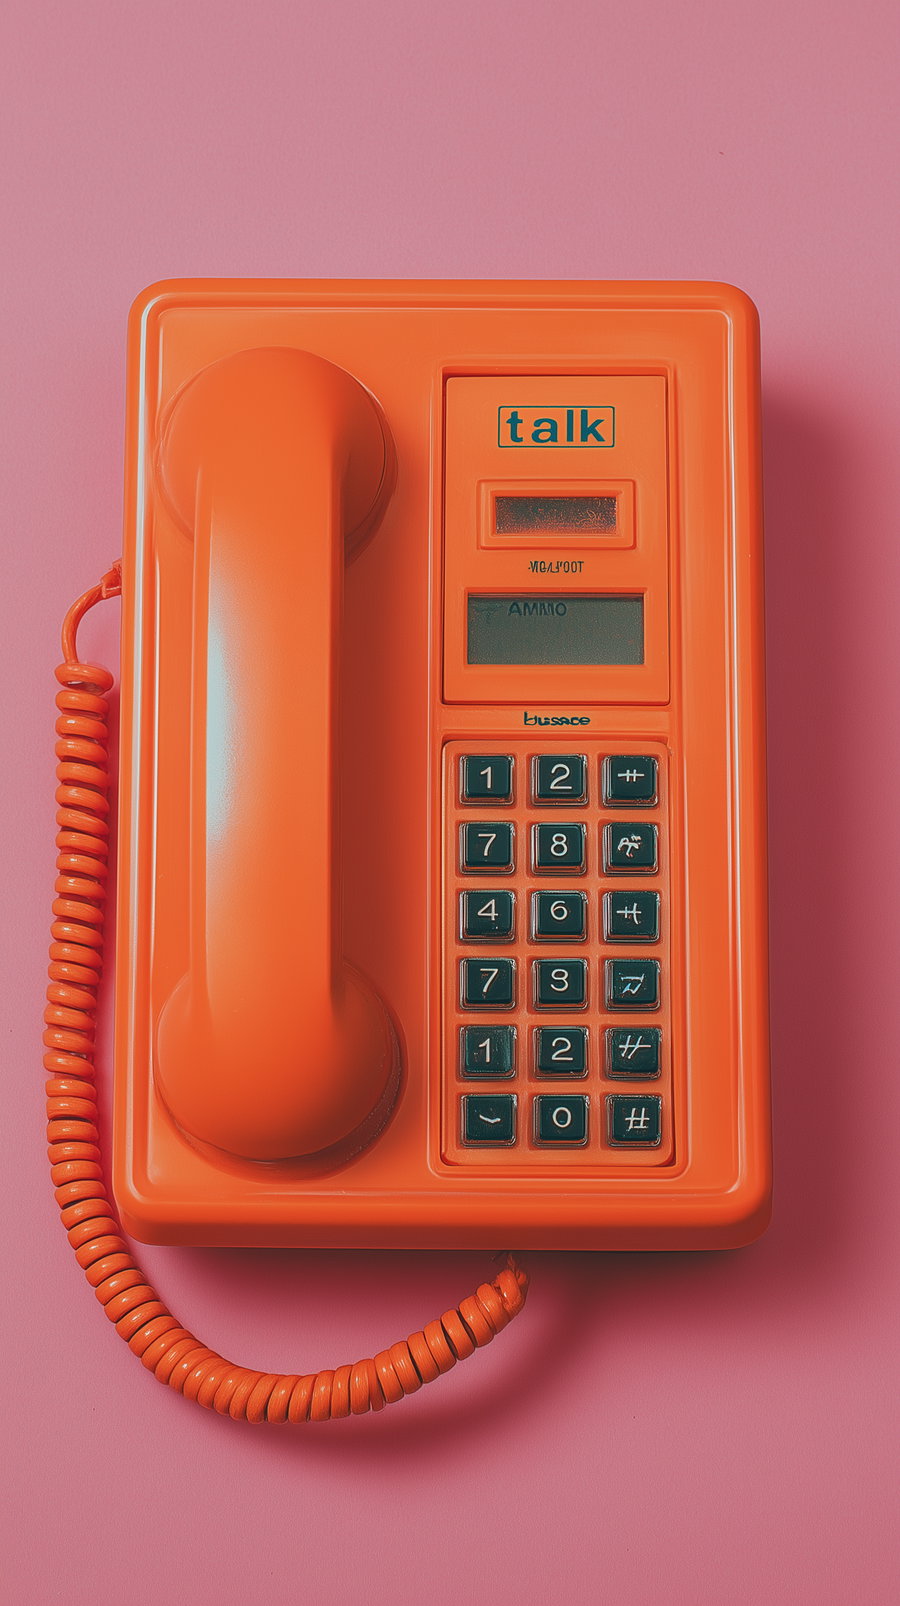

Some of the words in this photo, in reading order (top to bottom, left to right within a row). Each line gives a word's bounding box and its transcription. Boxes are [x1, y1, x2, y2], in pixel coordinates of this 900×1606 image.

[506, 409, 606, 443] talk
[480, 766, 492, 789] 1
[550, 763, 573, 790] 2
[477, 833, 497, 856] 7
[550, 833, 568, 857] 8
[477, 898, 499, 921] 4
[550, 900, 568, 921] 6
[479, 968, 499, 993] 7
[478, 1037, 491, 1063] 1
[551, 1037, 574, 1061] 2
